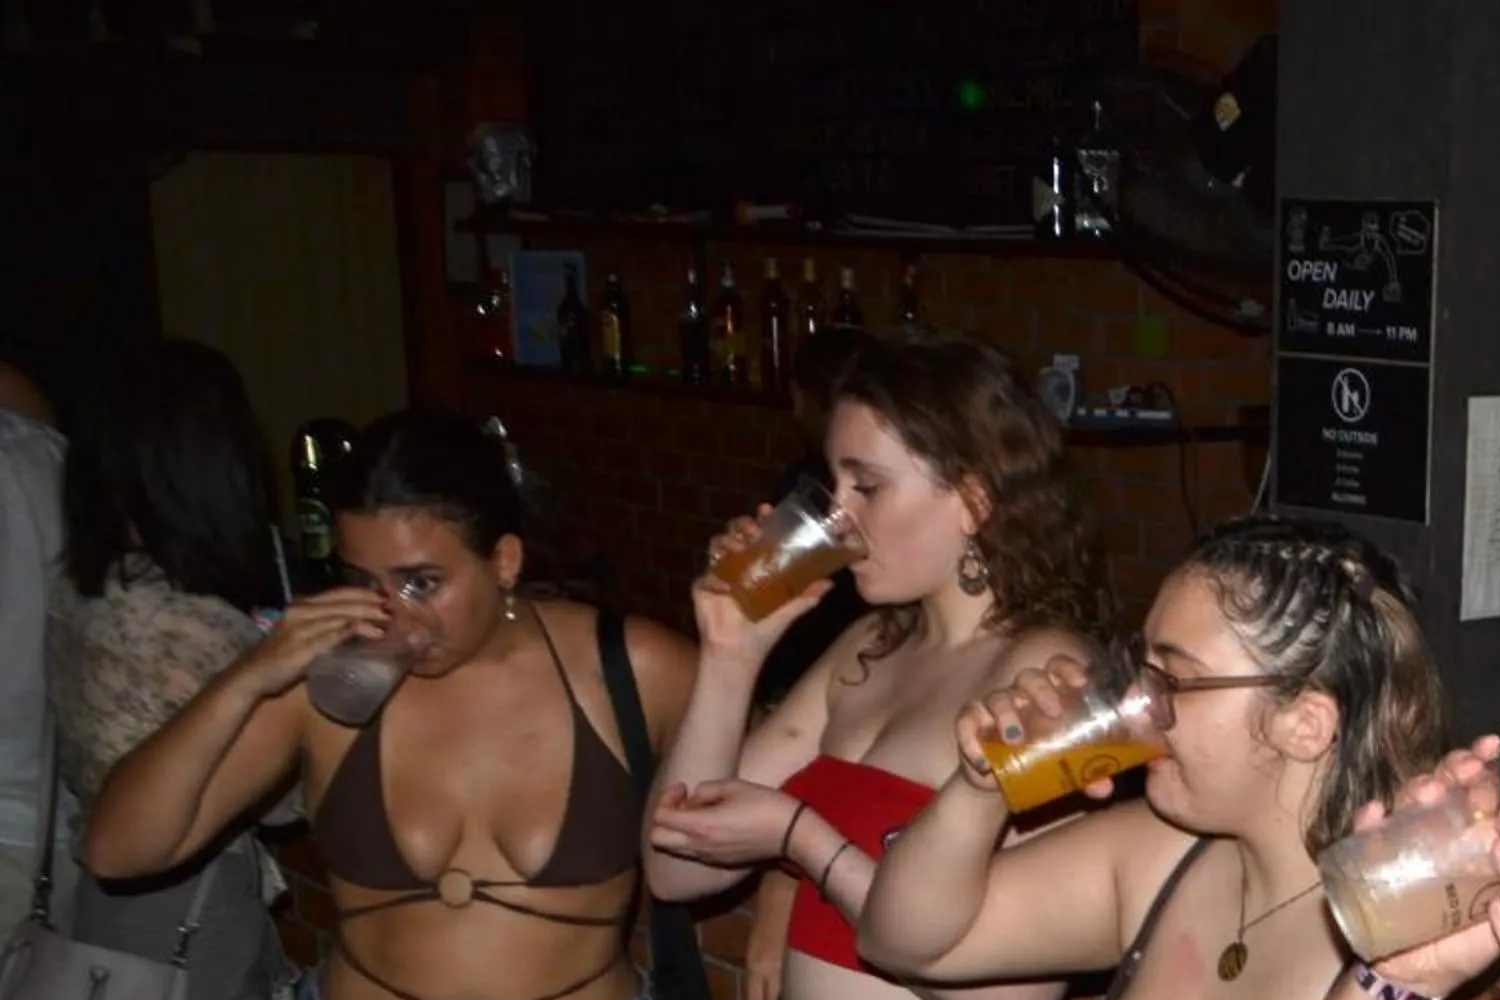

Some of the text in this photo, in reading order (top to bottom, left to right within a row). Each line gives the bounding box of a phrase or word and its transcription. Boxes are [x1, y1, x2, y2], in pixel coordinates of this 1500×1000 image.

[1287, 259, 1338, 282] OPEN
[1322, 287, 1375, 312] DAILY
[1337, 322, 1355, 337] AM
[1399, 326, 1417, 342] PM
